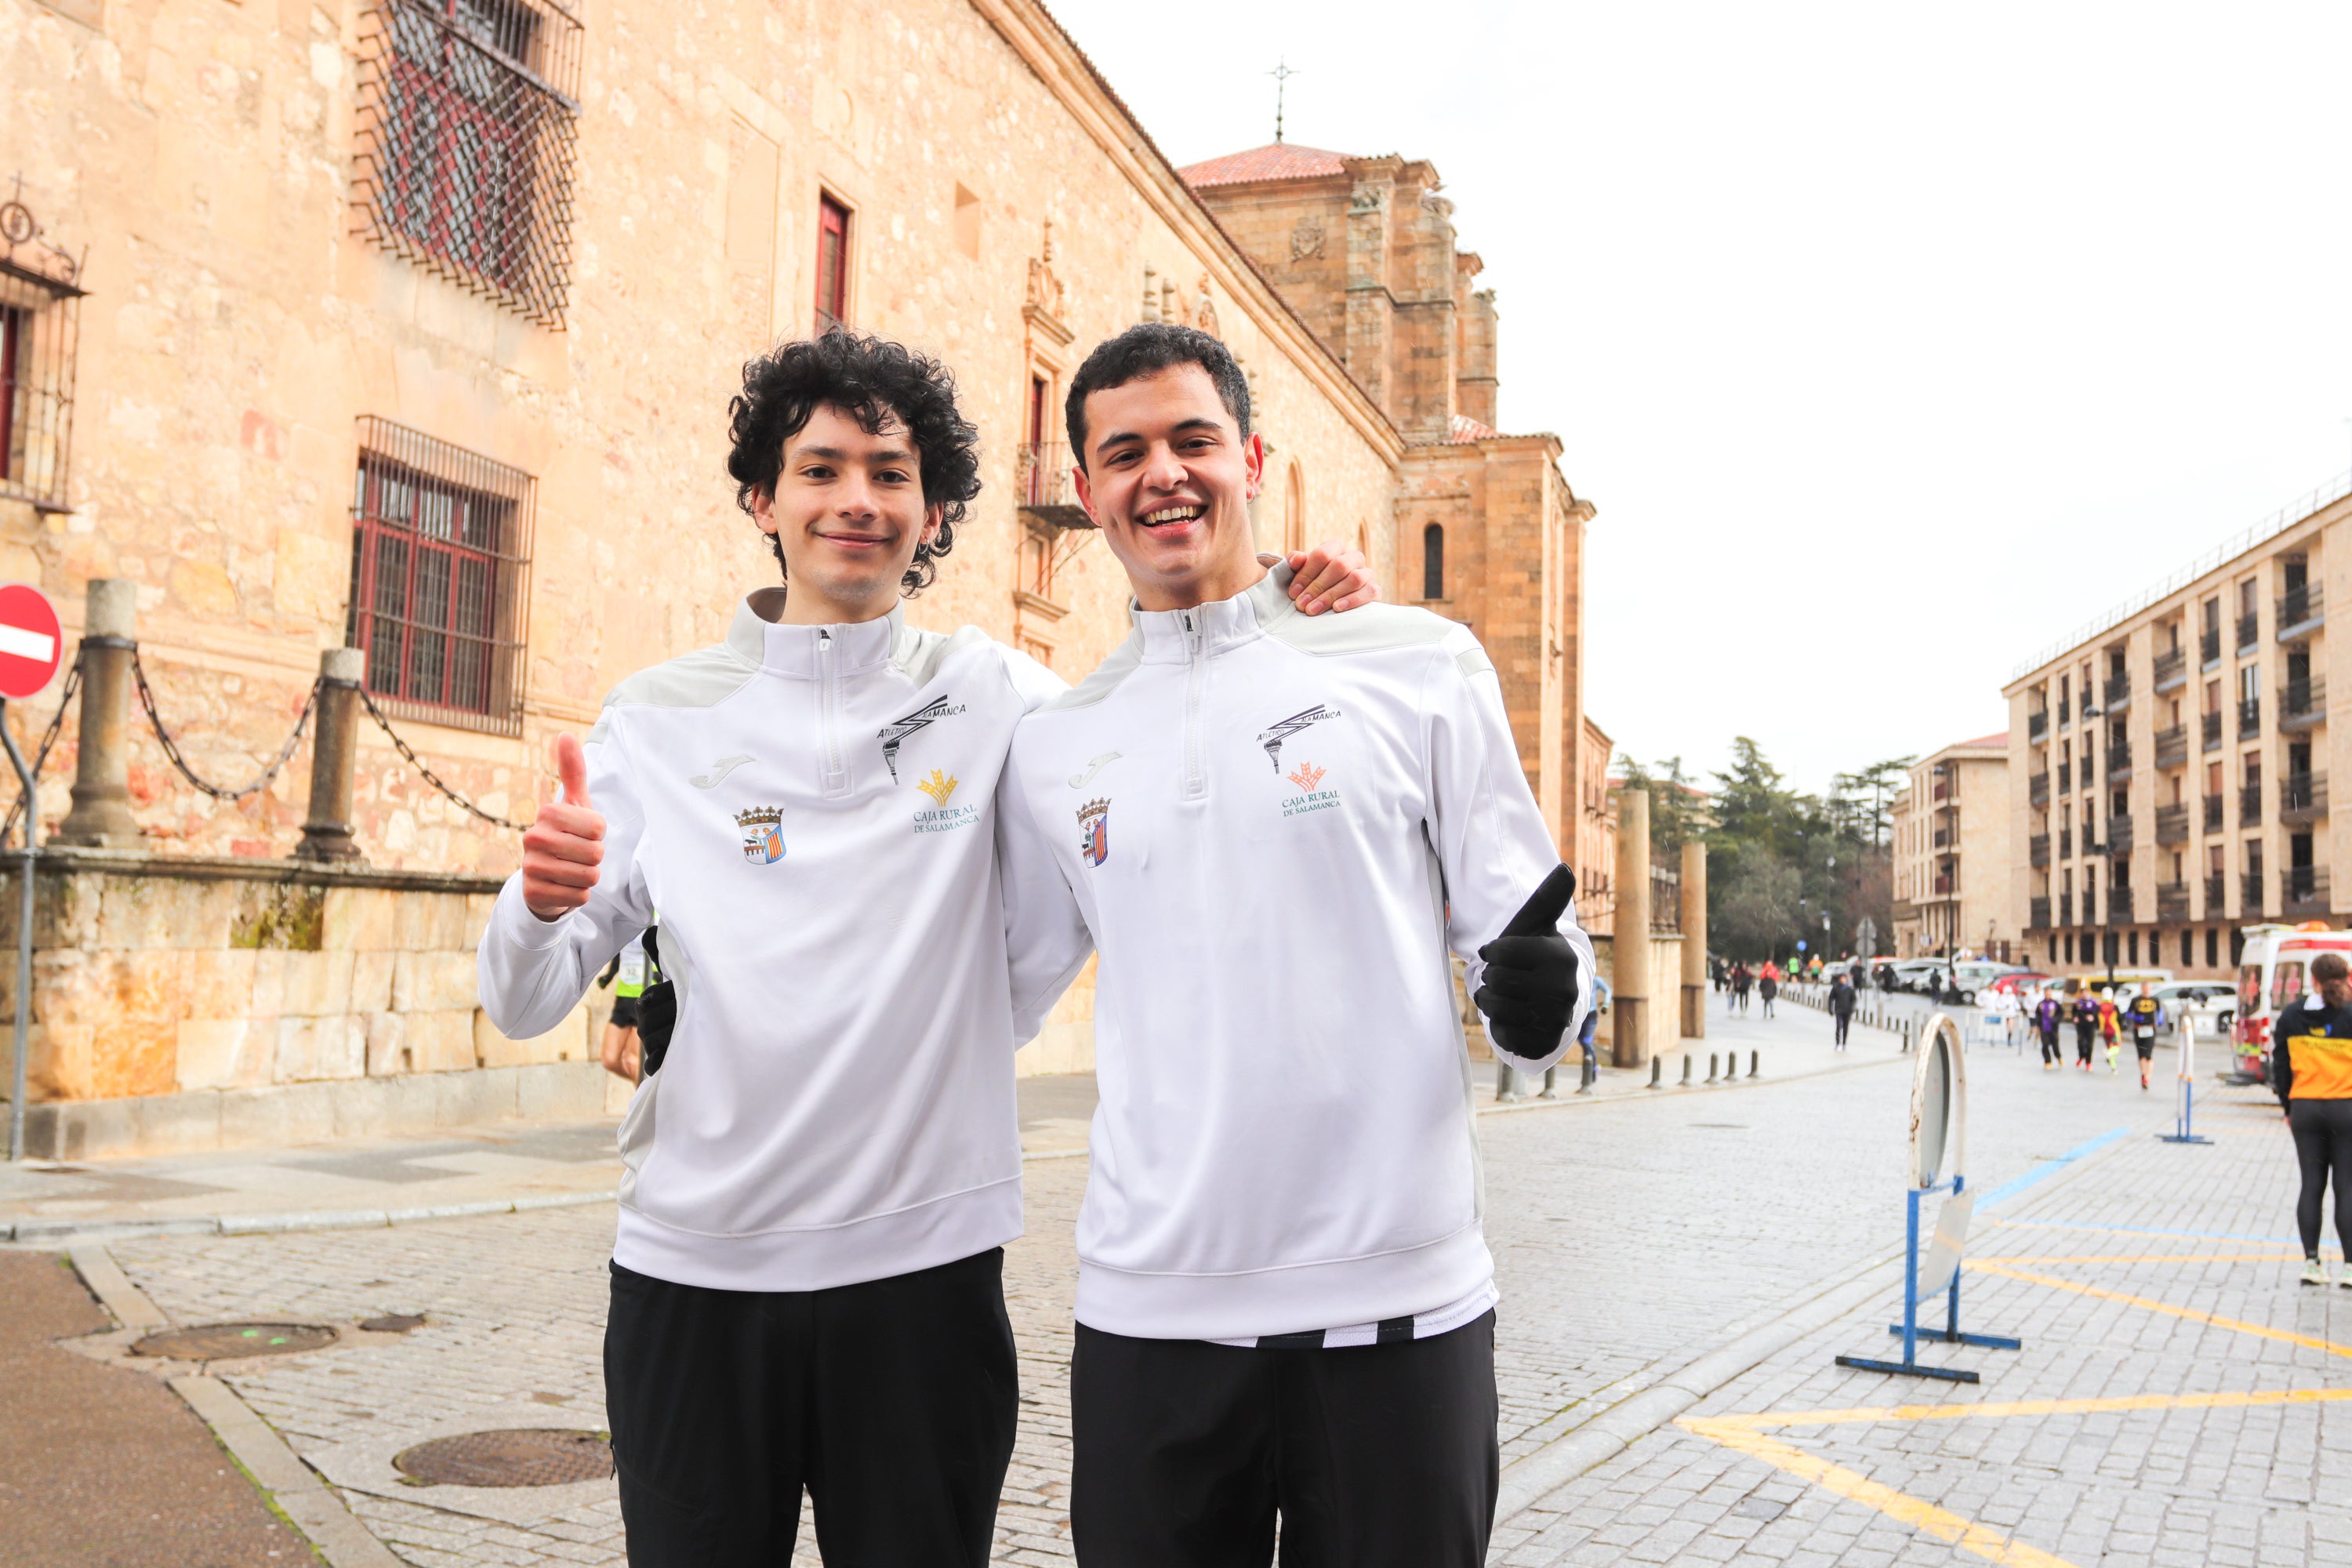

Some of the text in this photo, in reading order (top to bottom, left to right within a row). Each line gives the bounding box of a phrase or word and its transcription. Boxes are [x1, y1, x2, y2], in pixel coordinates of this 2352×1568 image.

[1282, 790, 1341, 808] CAJA RURAL
[913, 804, 978, 824] CAJA RURAL
[1283, 800, 1341, 817] DE SALAMANCA
[914, 815, 980, 833] DE SALAMANCA
